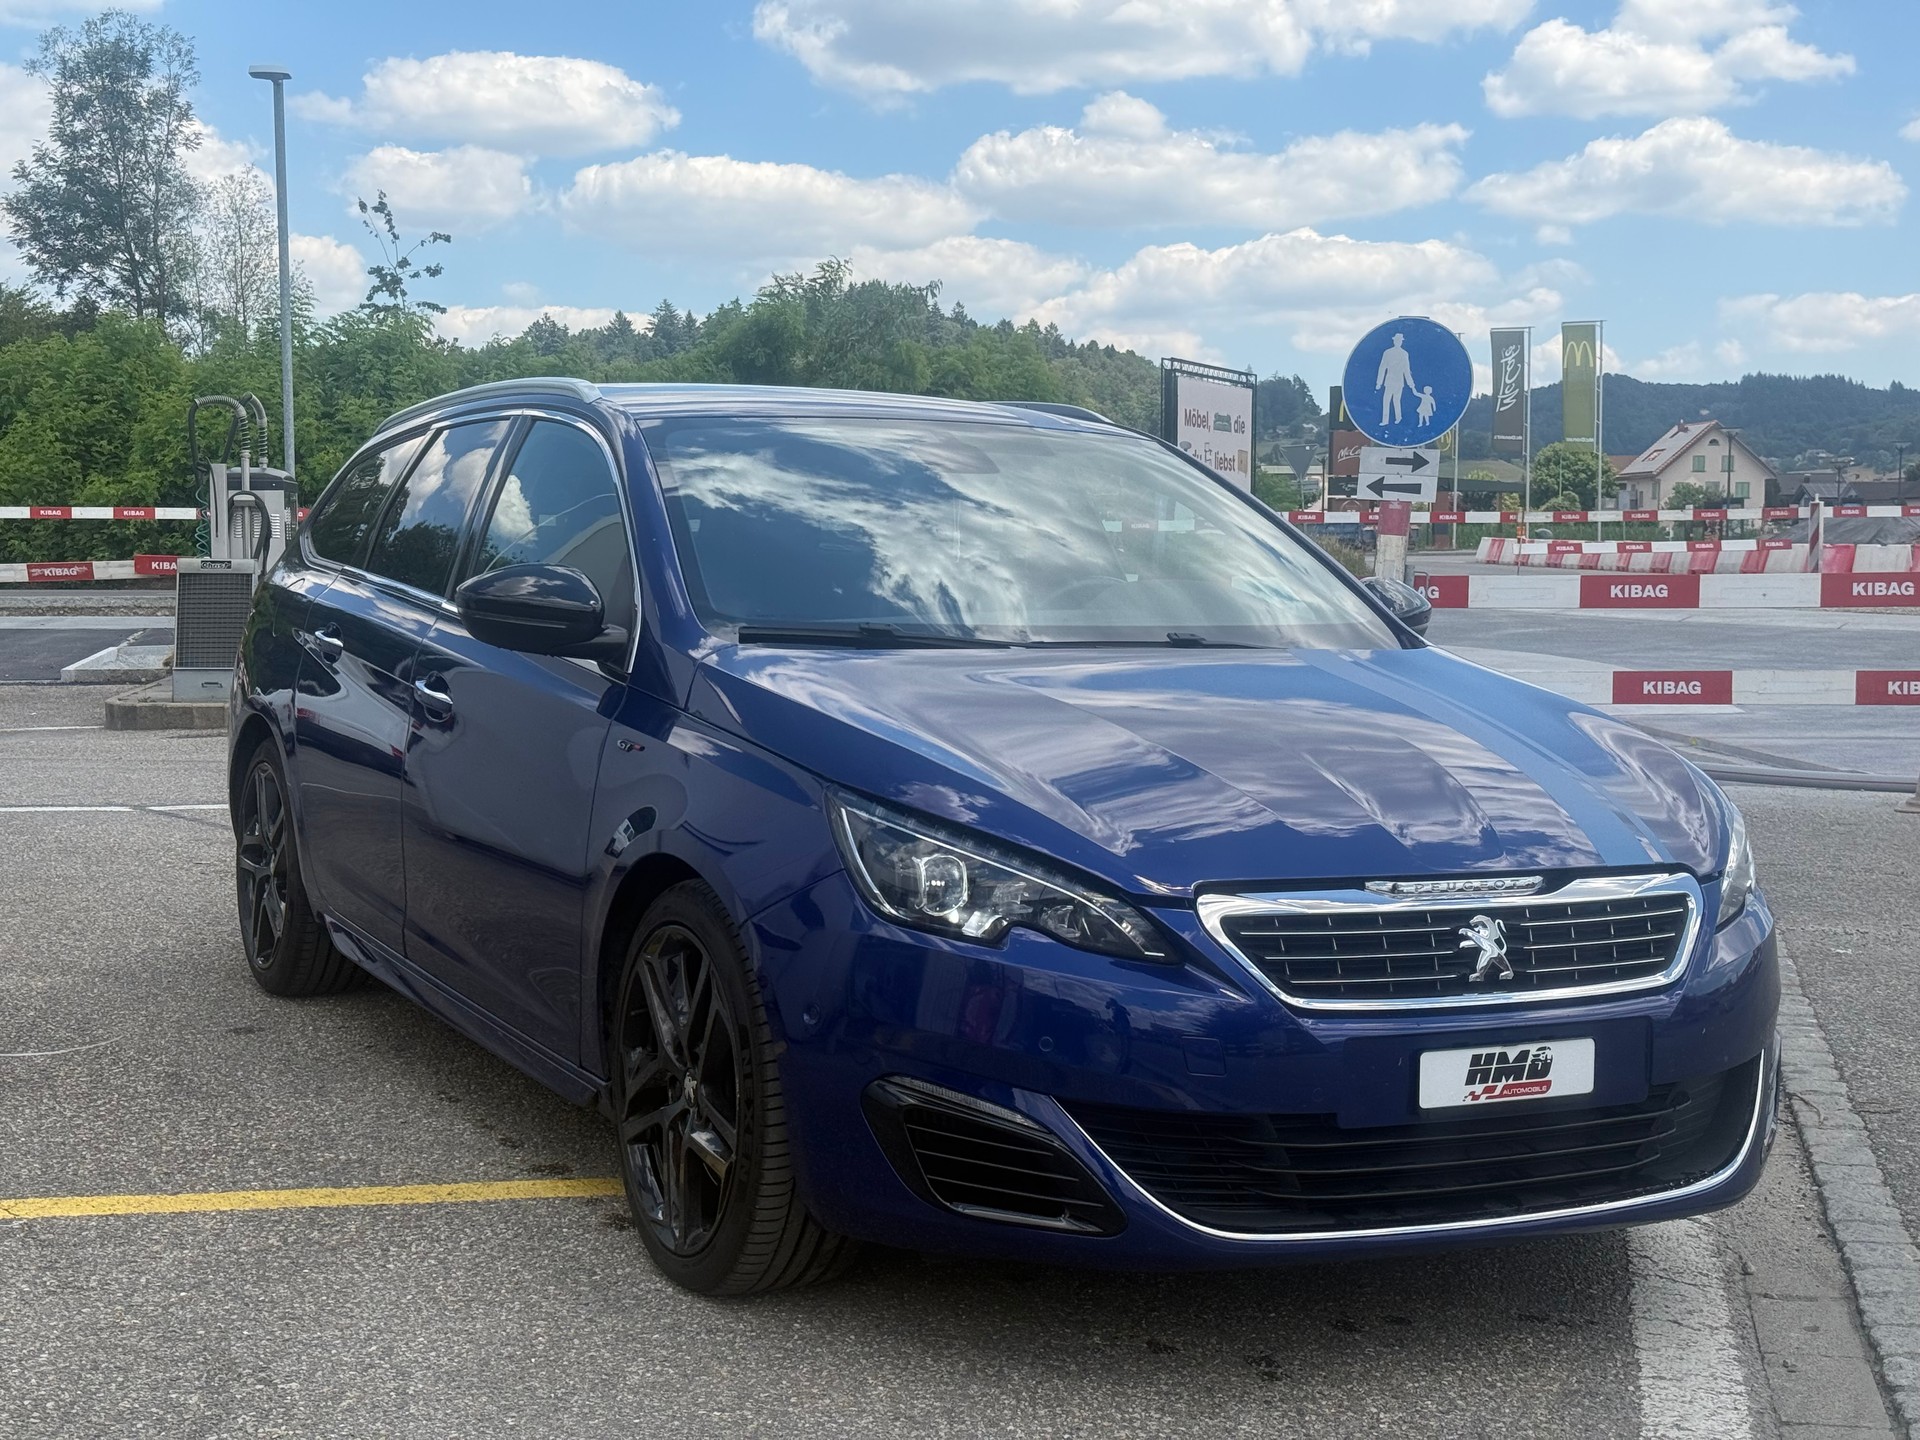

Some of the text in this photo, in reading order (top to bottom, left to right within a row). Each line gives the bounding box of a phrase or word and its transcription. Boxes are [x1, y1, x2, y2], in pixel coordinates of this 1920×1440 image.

[1184, 408, 1246, 434] Möbel, die
[1214, 450, 1236, 472] liebst
[44, 567, 77, 577] KIBAG
[1610, 584, 1668, 598] KIBAG
[1853, 582, 1915, 596] KIBAG
[1643, 681, 1702, 695] KIBAG
[1414, 879, 1520, 893] PEUGEOT
[1502, 1085, 1547, 1095] AUTOMOBILE
